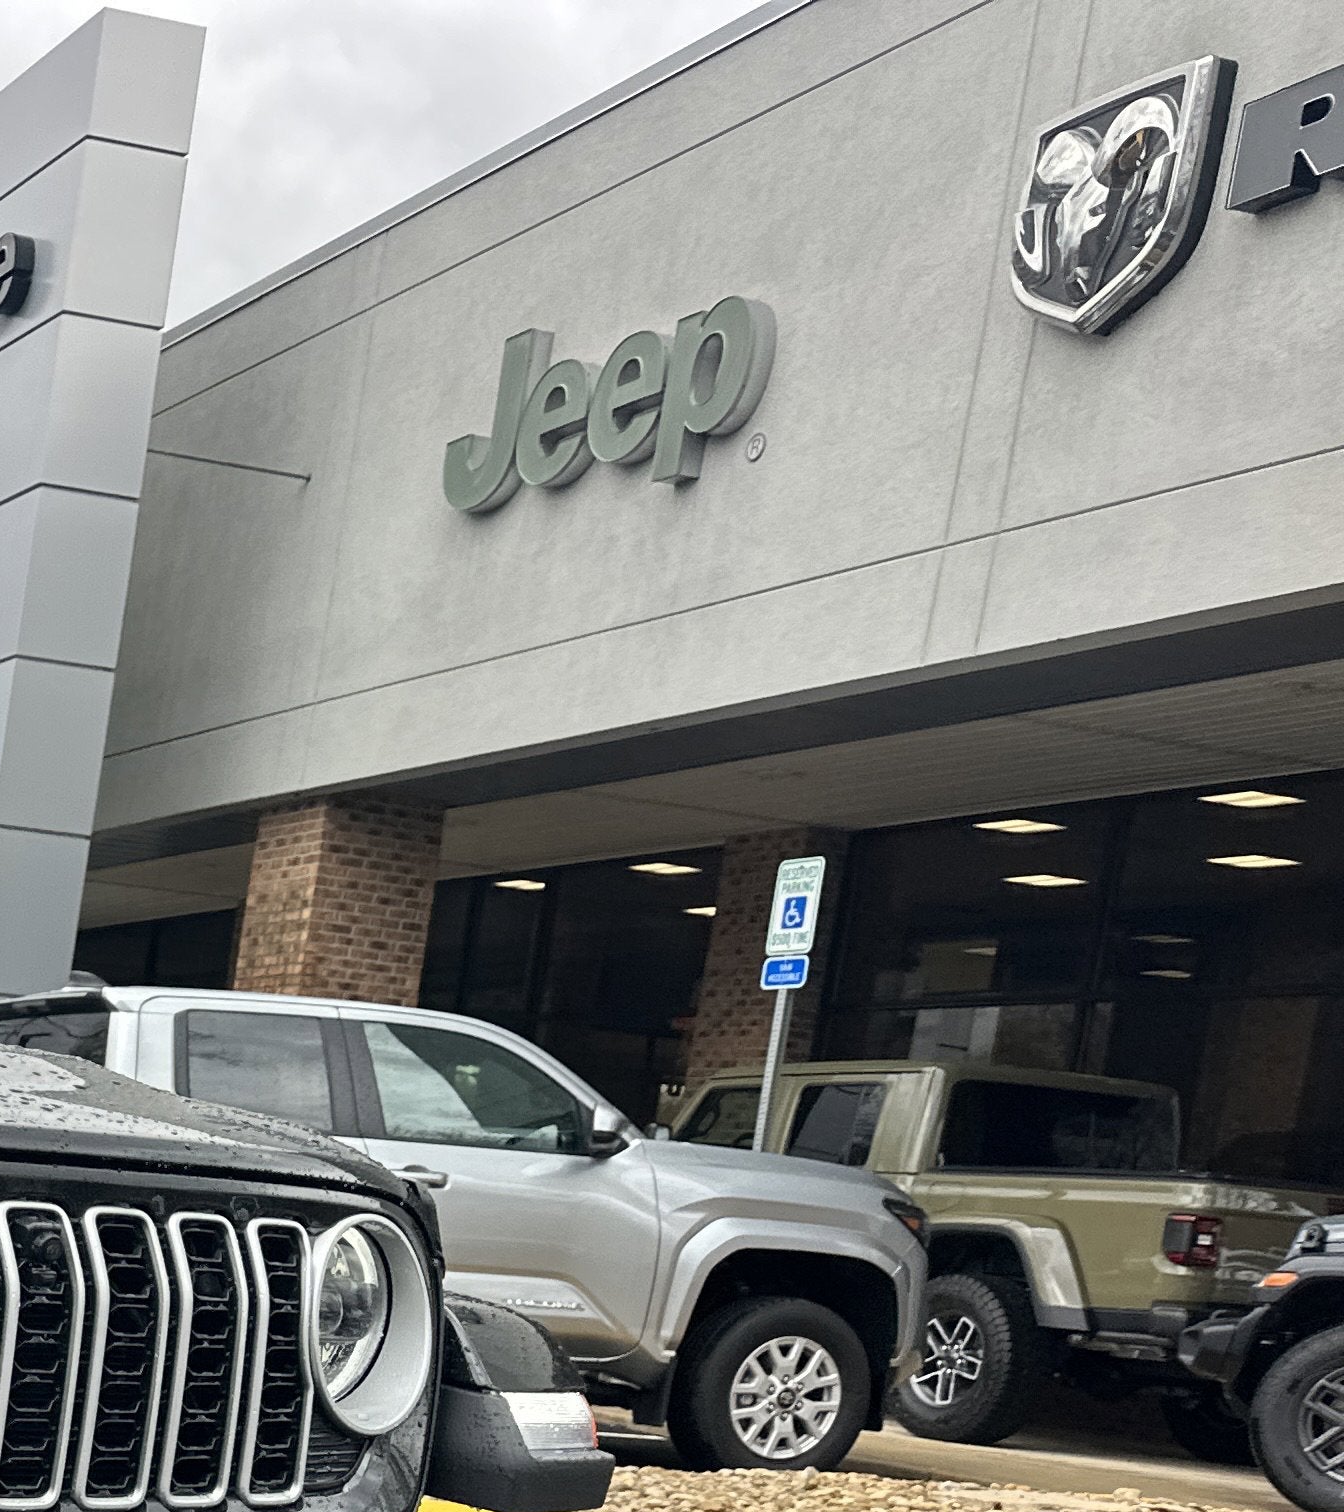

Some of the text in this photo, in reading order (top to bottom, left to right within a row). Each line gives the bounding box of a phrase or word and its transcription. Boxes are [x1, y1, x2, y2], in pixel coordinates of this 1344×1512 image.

[442, 295, 777, 514] Jeep
[782, 865, 820, 880] RESERVED
[782, 881, 815, 893] PARKING
[792, 930, 809, 944] FINE
